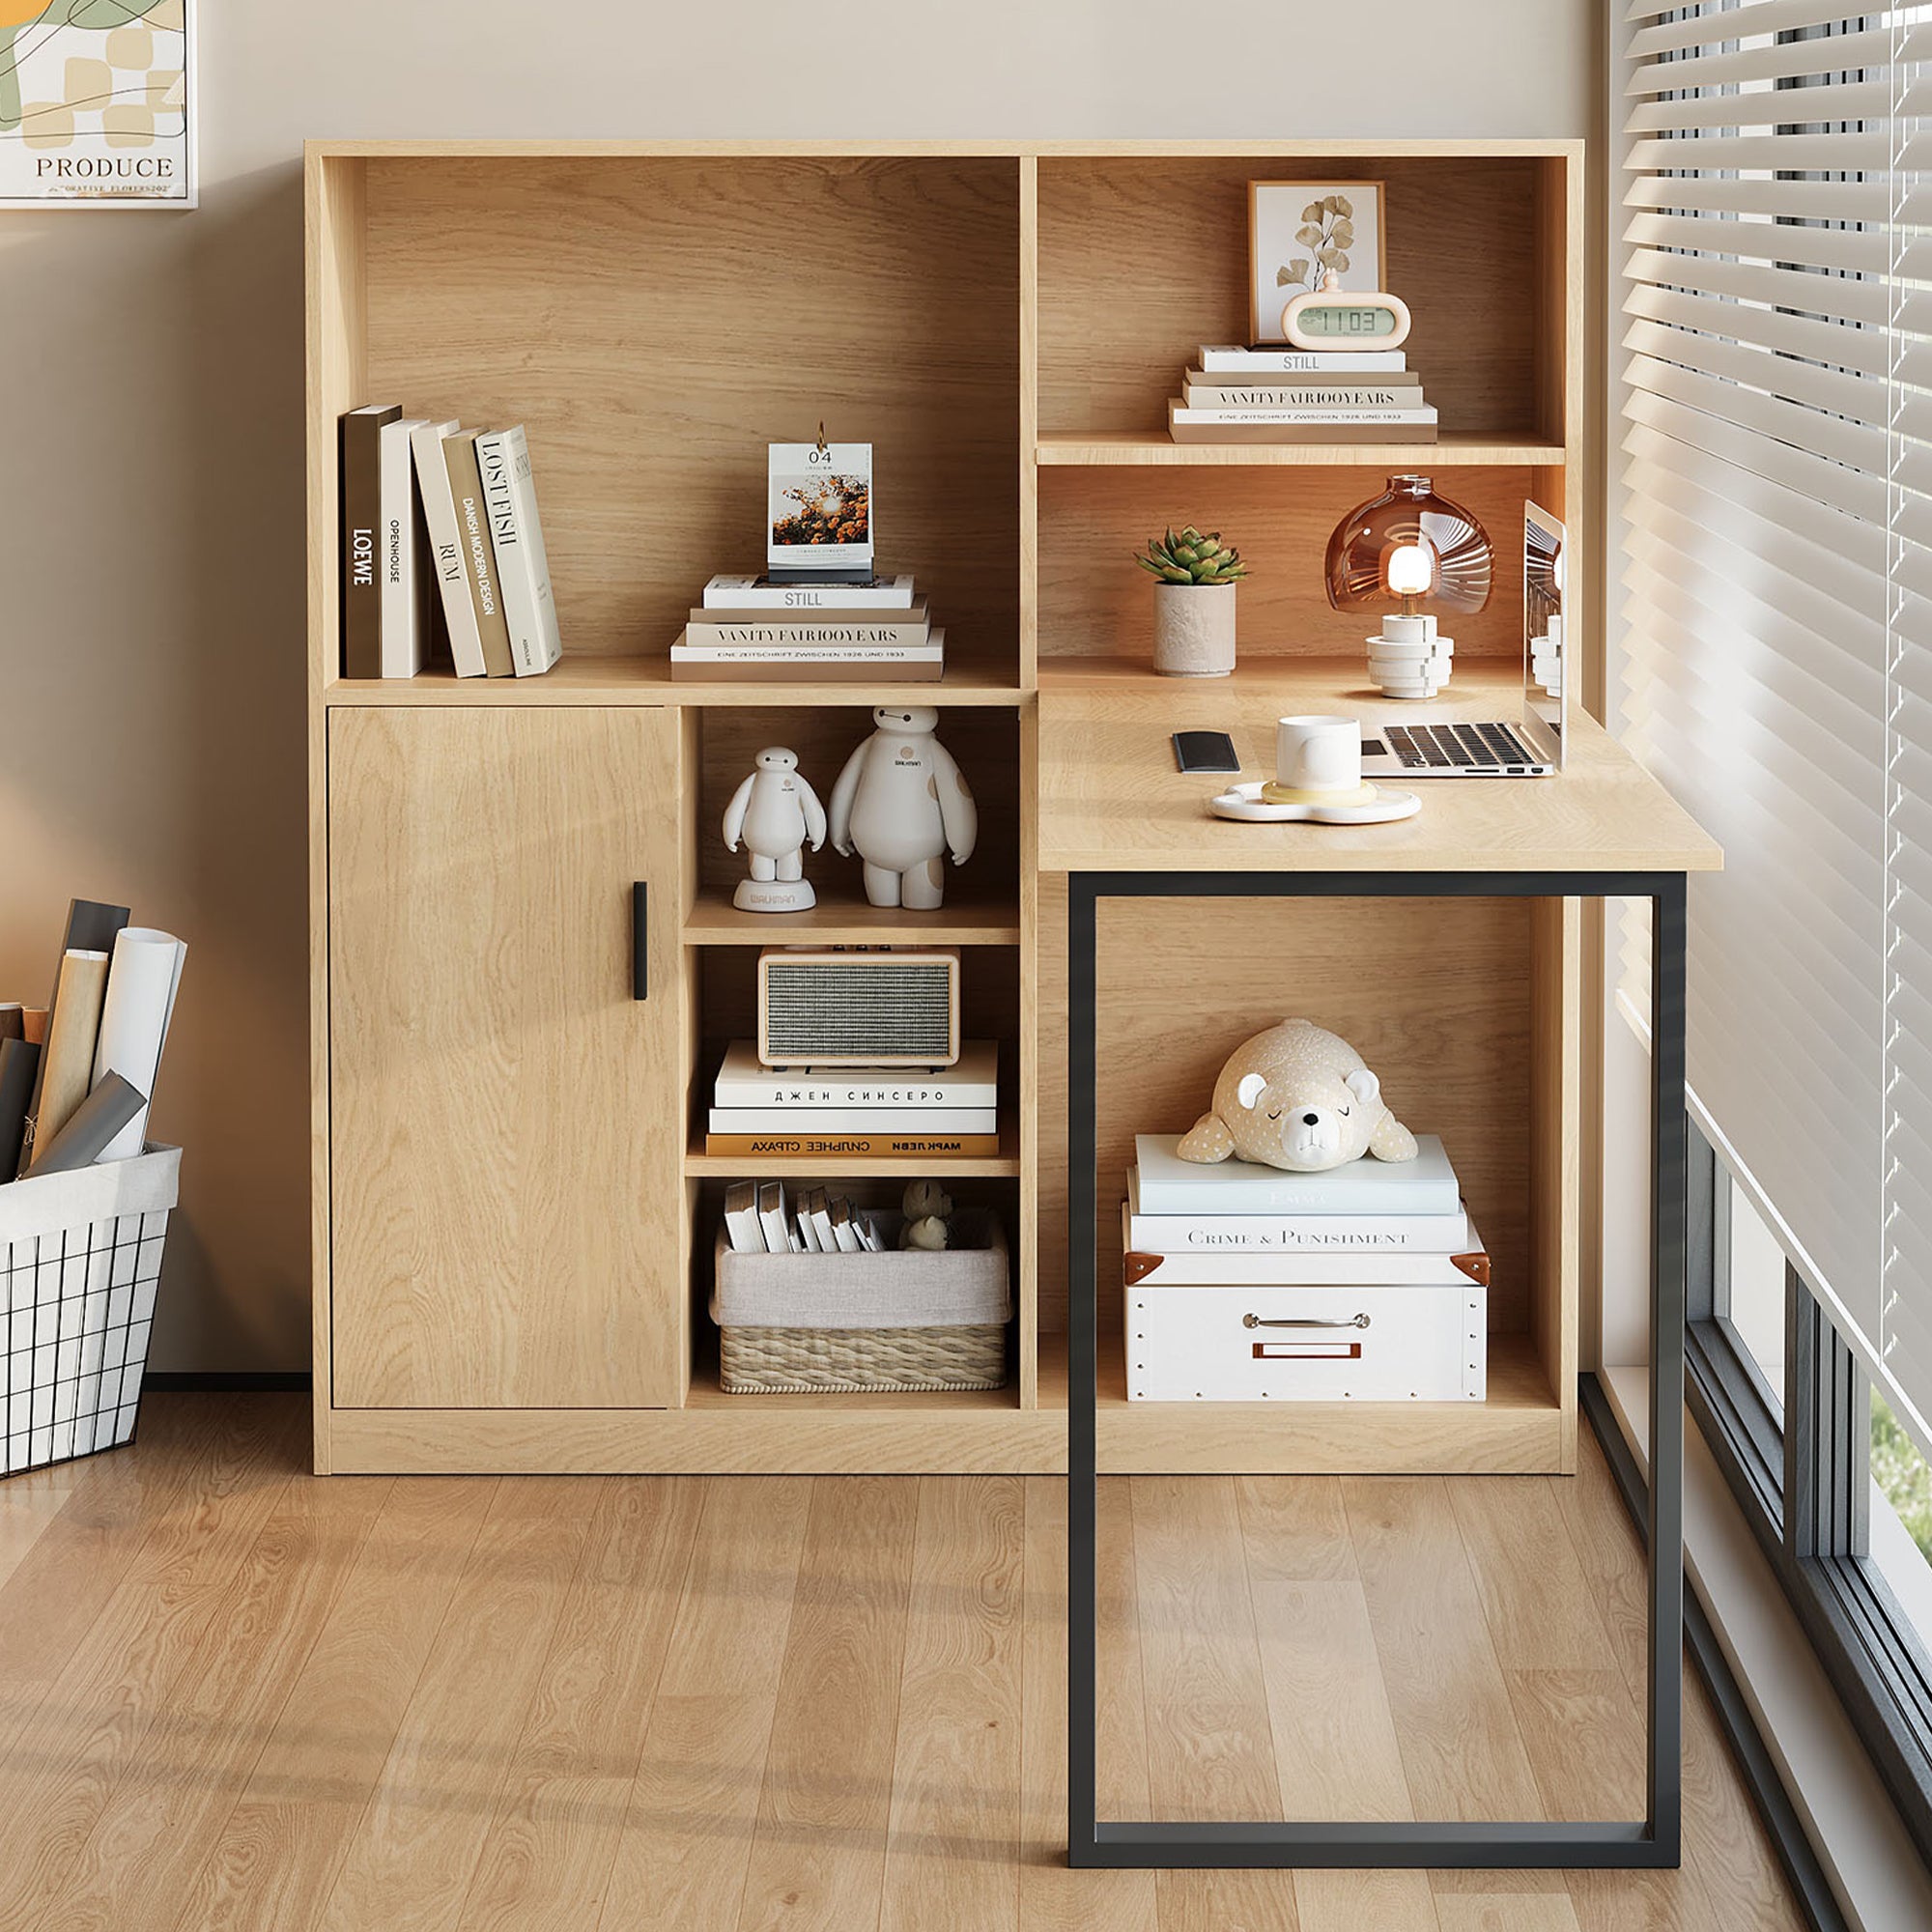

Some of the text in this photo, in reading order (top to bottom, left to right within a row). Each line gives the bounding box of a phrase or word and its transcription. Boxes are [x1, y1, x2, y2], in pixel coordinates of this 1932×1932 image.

[36, 157, 174, 178] PRODUCE
[1283, 355, 1320, 370] STILL
[1219, 392, 1275, 405] VANITY
[808, 451, 832, 464] 04
[483, 441, 517, 546] LOST FISH
[353, 528, 373, 585] LOEWE
[389, 519, 400, 583] OPENHOUSE
[463, 497, 496, 615] DANISH MODERN DESIGN
[439, 543, 461, 582] RUM
[784, 591, 822, 607] STILL
[718, 629, 775, 641] VANITY
[774, 1091, 945, 1102] ДЖЕН СИНСЕРО
[1187, 1230, 1410, 1246] CRIME & PUNISHMENT
